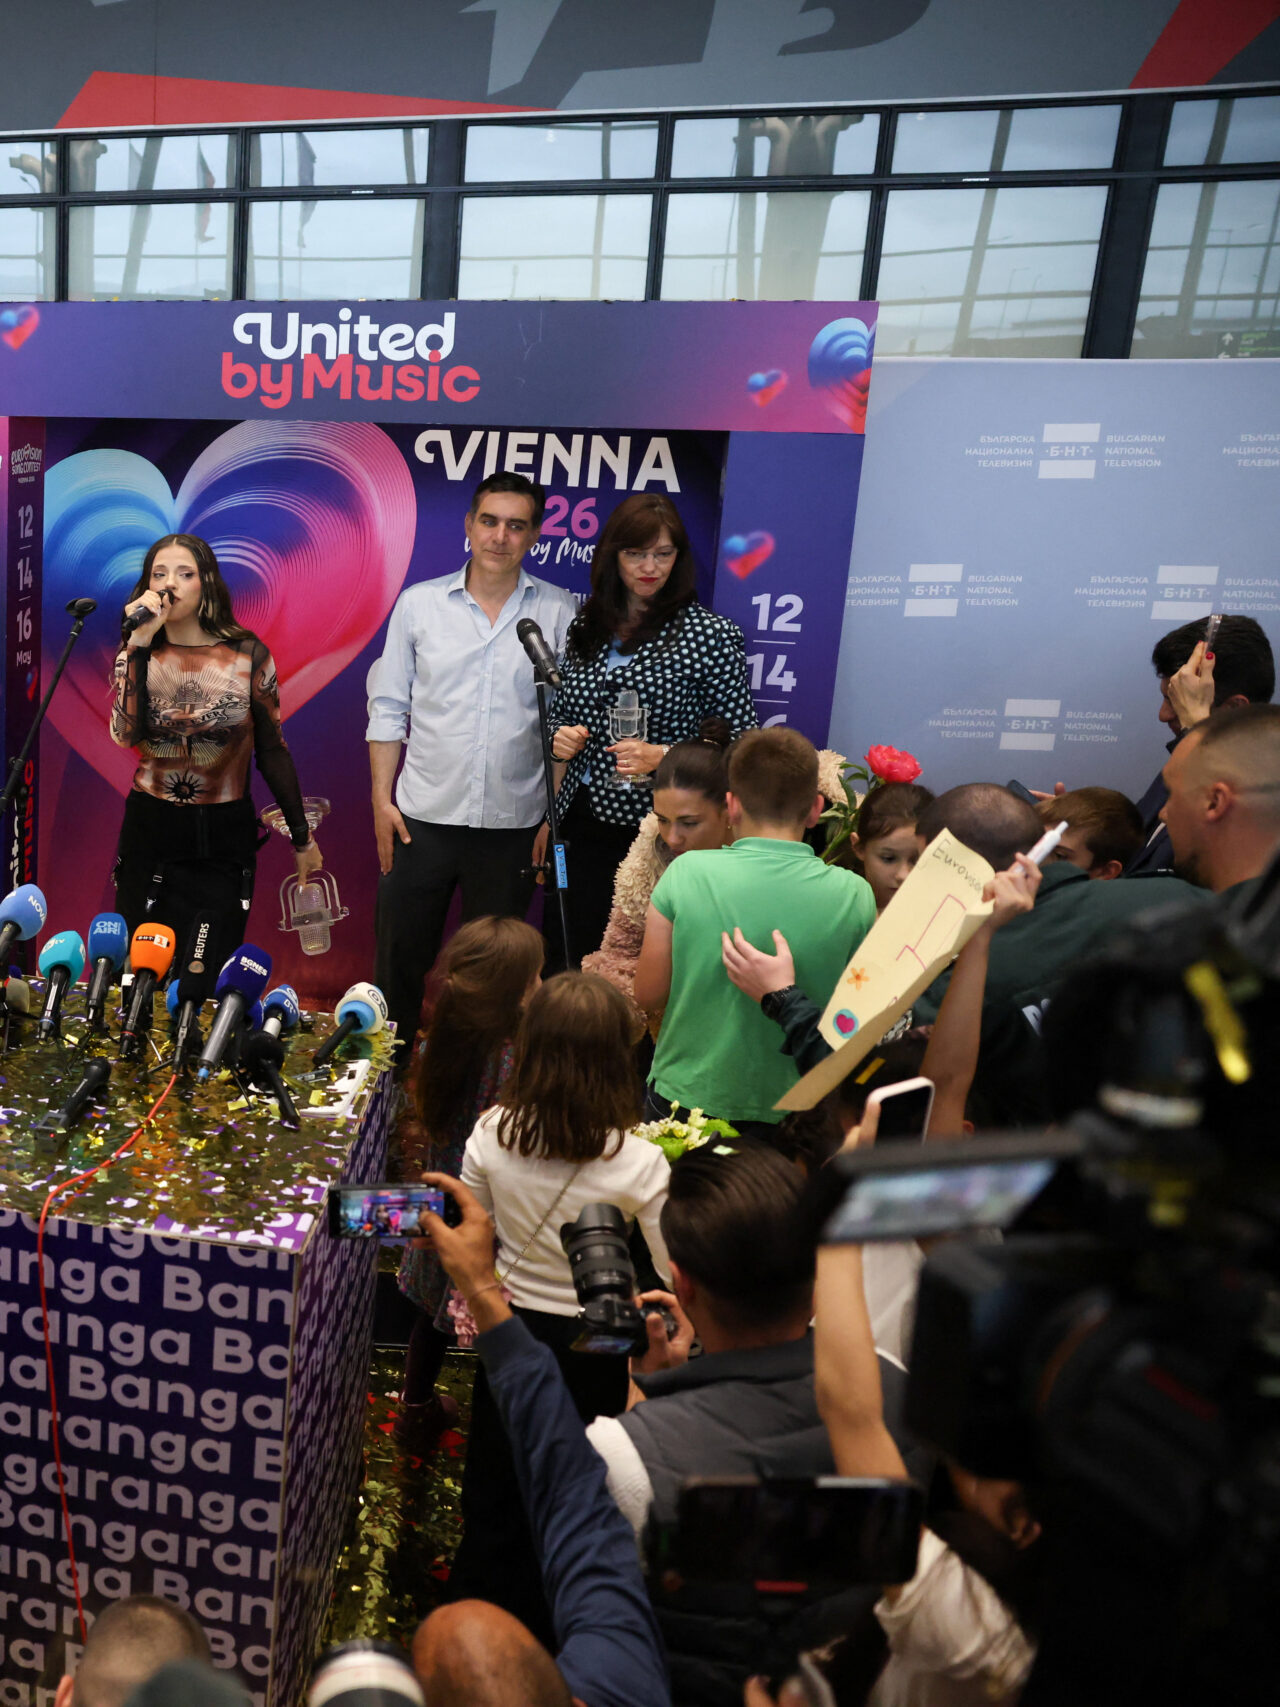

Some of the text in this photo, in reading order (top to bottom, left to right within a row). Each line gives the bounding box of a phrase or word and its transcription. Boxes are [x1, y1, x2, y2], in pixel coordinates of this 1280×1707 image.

[232, 307, 456, 361] United
[222, 350, 481, 409] by Music
[980, 435, 1035, 443] БЪЛГАРСКА
[1106, 435, 1166, 443] BULGARIAN
[965, 447, 1034, 456] НАЦИОНАЛНА
[1104, 447, 1156, 455] NATIONAL
[414, 430, 681, 493] VIENNA
[977, 460, 1033, 468] ТЕЛЕВИЗИЯ
[1103, 459, 1161, 467] TELEVISION
[18, 504, 34, 539] 12
[540, 495, 599, 539] 26
[556, 537, 596, 566] Mus
[17, 557, 32, 591] 14
[848, 575, 902, 583] БЪЛГАРСКА
[968, 575, 1022, 583] BULGARIAN
[1090, 576, 1149, 584] БЪЛГАРСКА
[847, 587, 901, 595] ЦИОНАЛНА
[1074, 588, 1147, 597] НАЦИОНАЛНА
[1222, 590, 1277, 598] NATIONAL
[846, 599, 899, 607] ТЕЛЕВИЗИЯ
[1088, 600, 1145, 608] ТЕЛЕВИЗИЯ
[752, 593, 804, 633] 12
[16, 607, 32, 642] 16
[16, 649, 32, 667] May
[746, 653, 797, 692] 14
[943, 708, 998, 716] БЪЛГАРСКА
[1066, 711, 1122, 720] BULGARIAN
[928, 720, 996, 728] НАЦИОНАЛНА
[1064, 723, 1112, 731] NATIONAL
[1063, 734, 1118, 743] TELEVISION
[93, 927, 118, 936] AIR
[194, 922, 210, 959] REUTERS
[241, 956, 268, 977] BGNES
[163, 1264, 294, 1325] Ban
[68, 1354, 284, 1433] Banga
